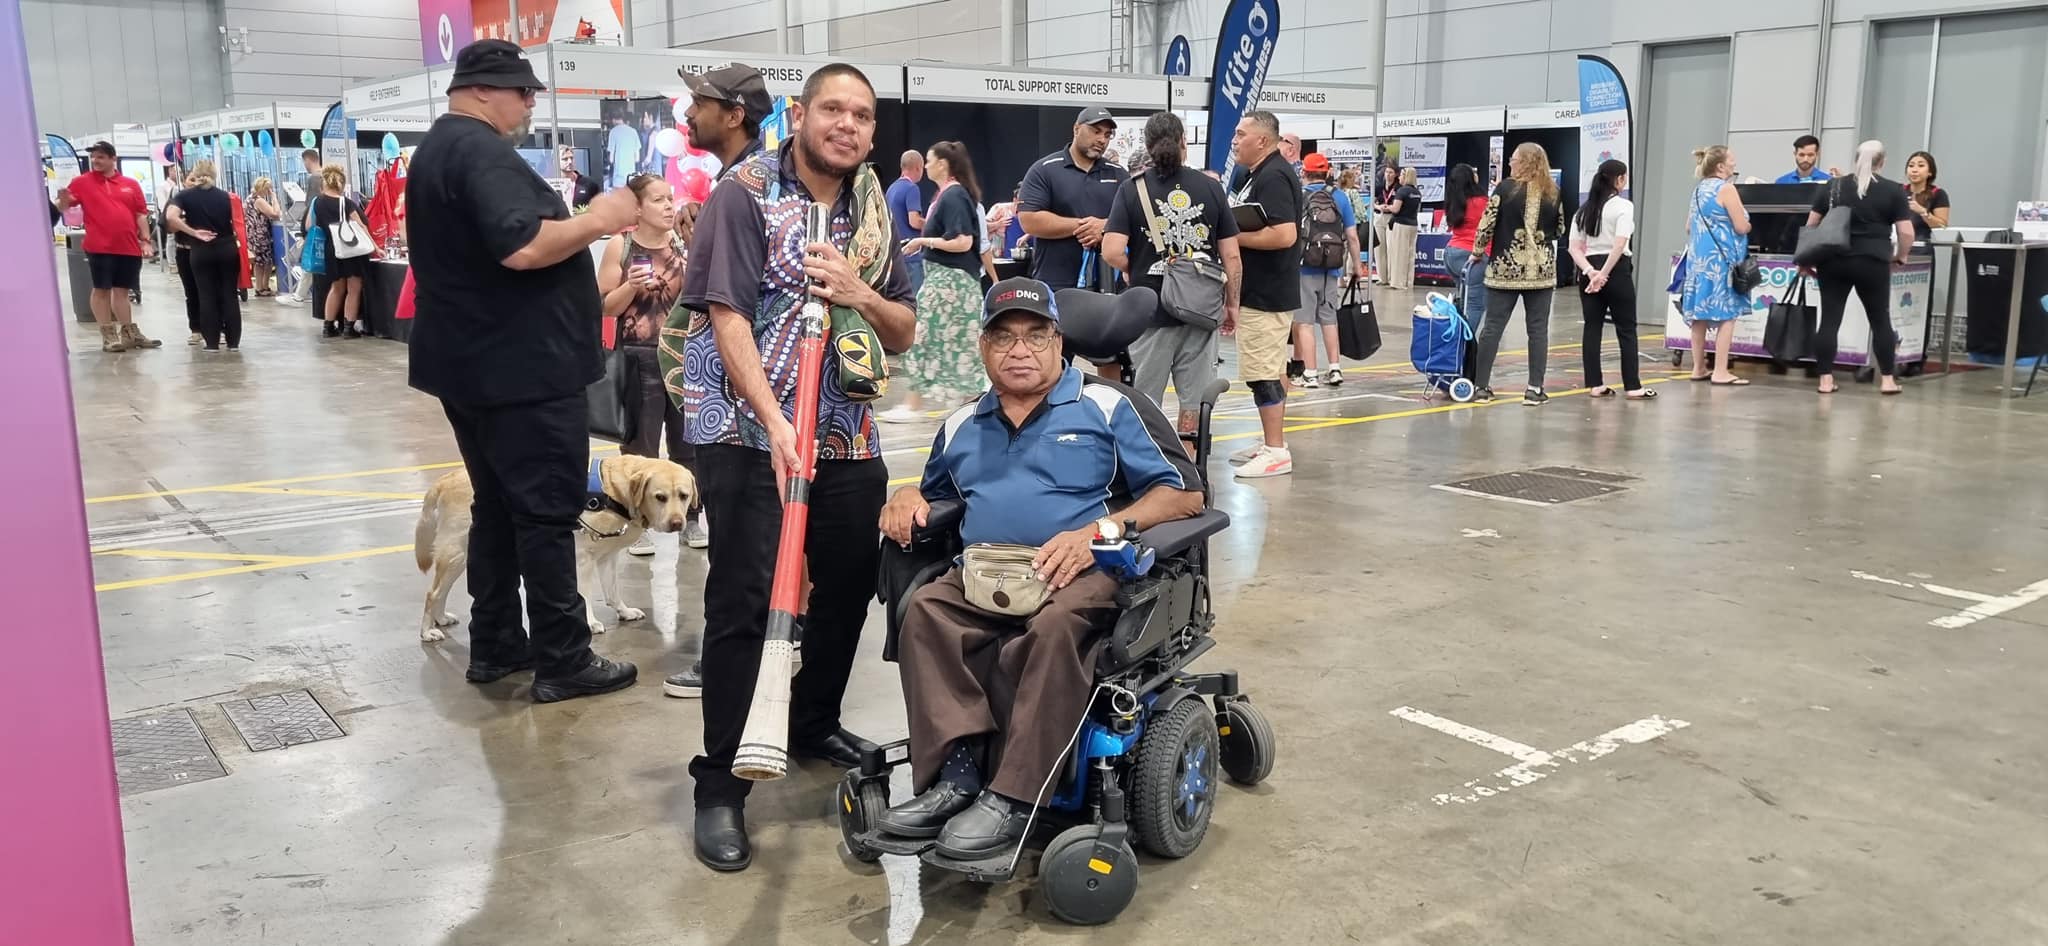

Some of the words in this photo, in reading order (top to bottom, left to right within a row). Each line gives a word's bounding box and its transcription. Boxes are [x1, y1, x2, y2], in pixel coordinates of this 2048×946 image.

[560, 61, 576, 71] 139
[1222, 34, 1255, 109] Kite
[913, 77, 925, 86] 137
[985, 79, 1016, 92] TOTAL
[1018, 80, 1062, 93] SUPPORT
[1064, 82, 1109, 96] SERVICES
[1175, 89, 1185, 97] 136
[1290, 92, 1326, 104] VEHICLES
[1382, 119, 1415, 128] SAFEMATE
[1415, 117, 1451, 126] AUSTRALIA
[1583, 121, 1608, 131] COFFEE
[1608, 119, 1626, 129] CART
[1591, 129, 1619, 138] NAMING
[1404, 151, 1426, 160] Lifeline
[1904, 272, 1929, 284] COFFEE
